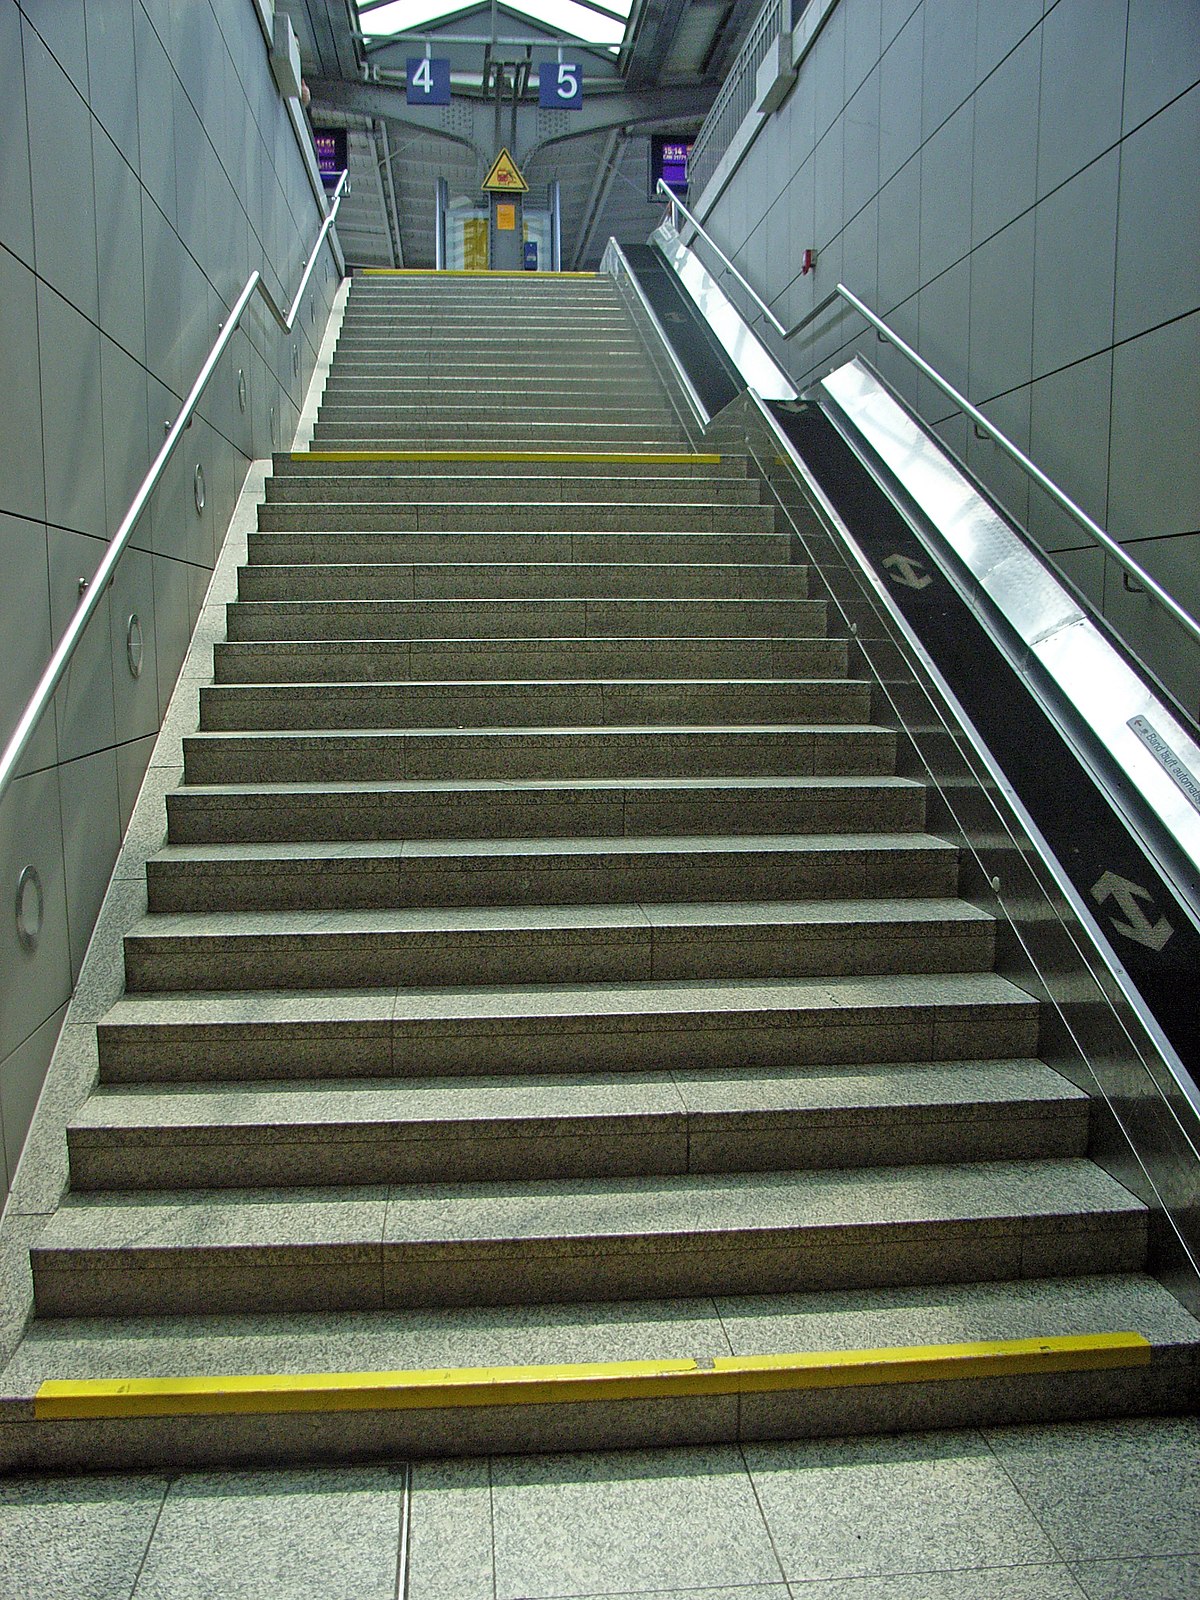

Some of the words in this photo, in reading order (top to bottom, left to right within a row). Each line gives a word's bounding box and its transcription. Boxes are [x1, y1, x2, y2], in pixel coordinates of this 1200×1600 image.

[412, 58, 434, 94] 4
[557, 64, 578, 99] 5
[1146, 732, 1165, 752] Band
[1172, 767, 1200, 805] automatis
